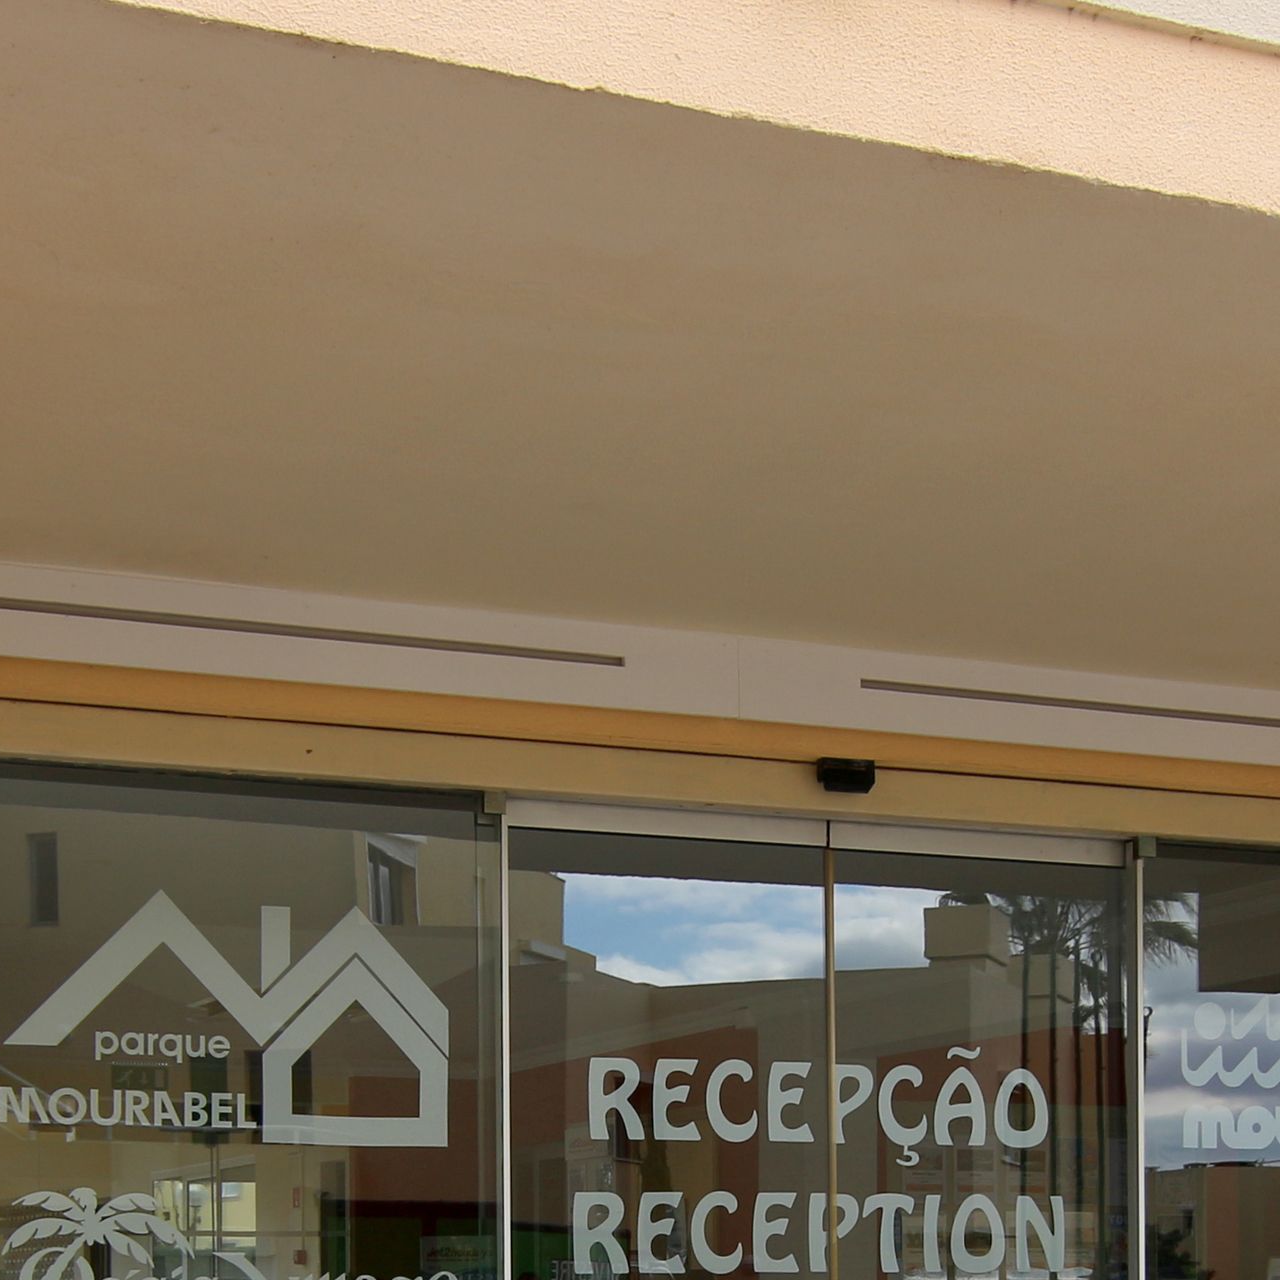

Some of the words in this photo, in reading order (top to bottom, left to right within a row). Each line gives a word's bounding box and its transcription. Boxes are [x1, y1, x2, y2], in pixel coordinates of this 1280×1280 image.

[95, 1029, 231, 1064] parque
[0, 1086, 257, 1129] MOURABEL
[587, 1046, 1049, 1167] RECEPÇÃO
[572, 1191, 1065, 1275] RECEPTION
